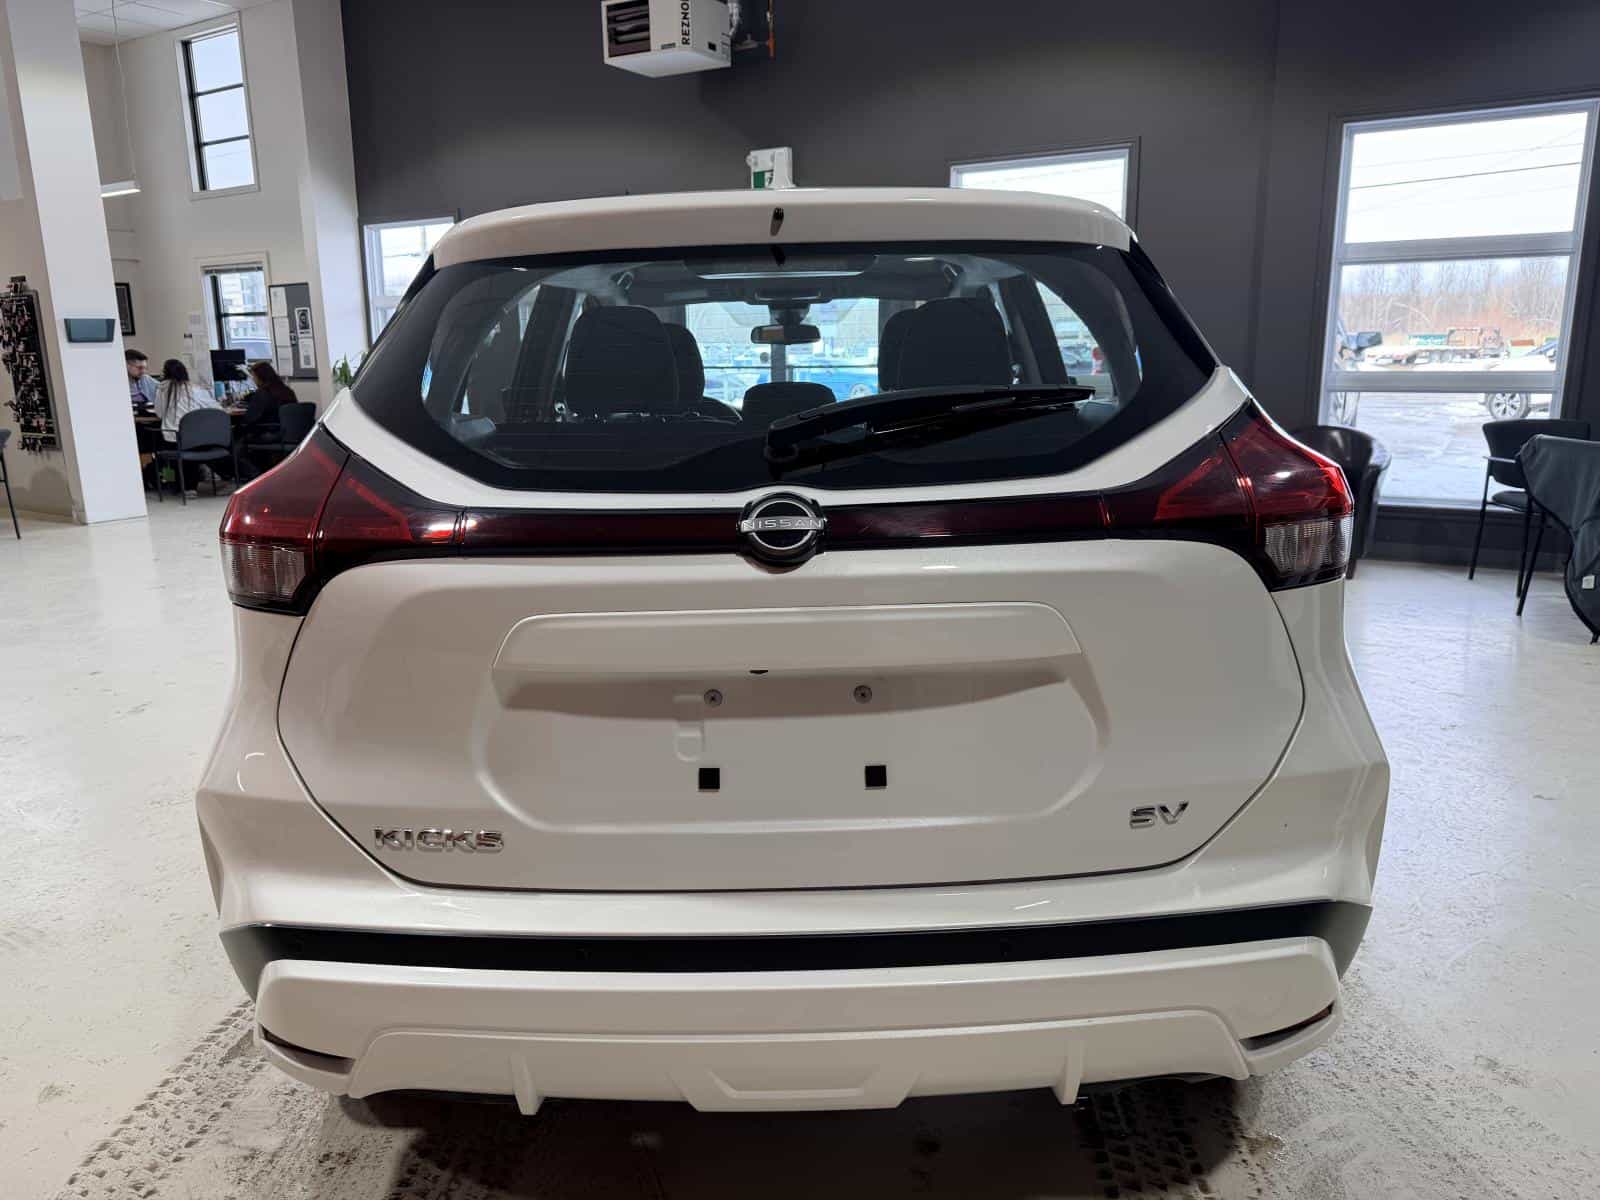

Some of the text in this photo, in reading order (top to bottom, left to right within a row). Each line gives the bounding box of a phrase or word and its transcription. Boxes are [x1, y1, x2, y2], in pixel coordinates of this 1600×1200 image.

[681, 0, 690, 45] REZNO
[743, 519, 822, 531] NISSAN
[1129, 801, 1189, 829] SV
[374, 827, 504, 852] KICKS
